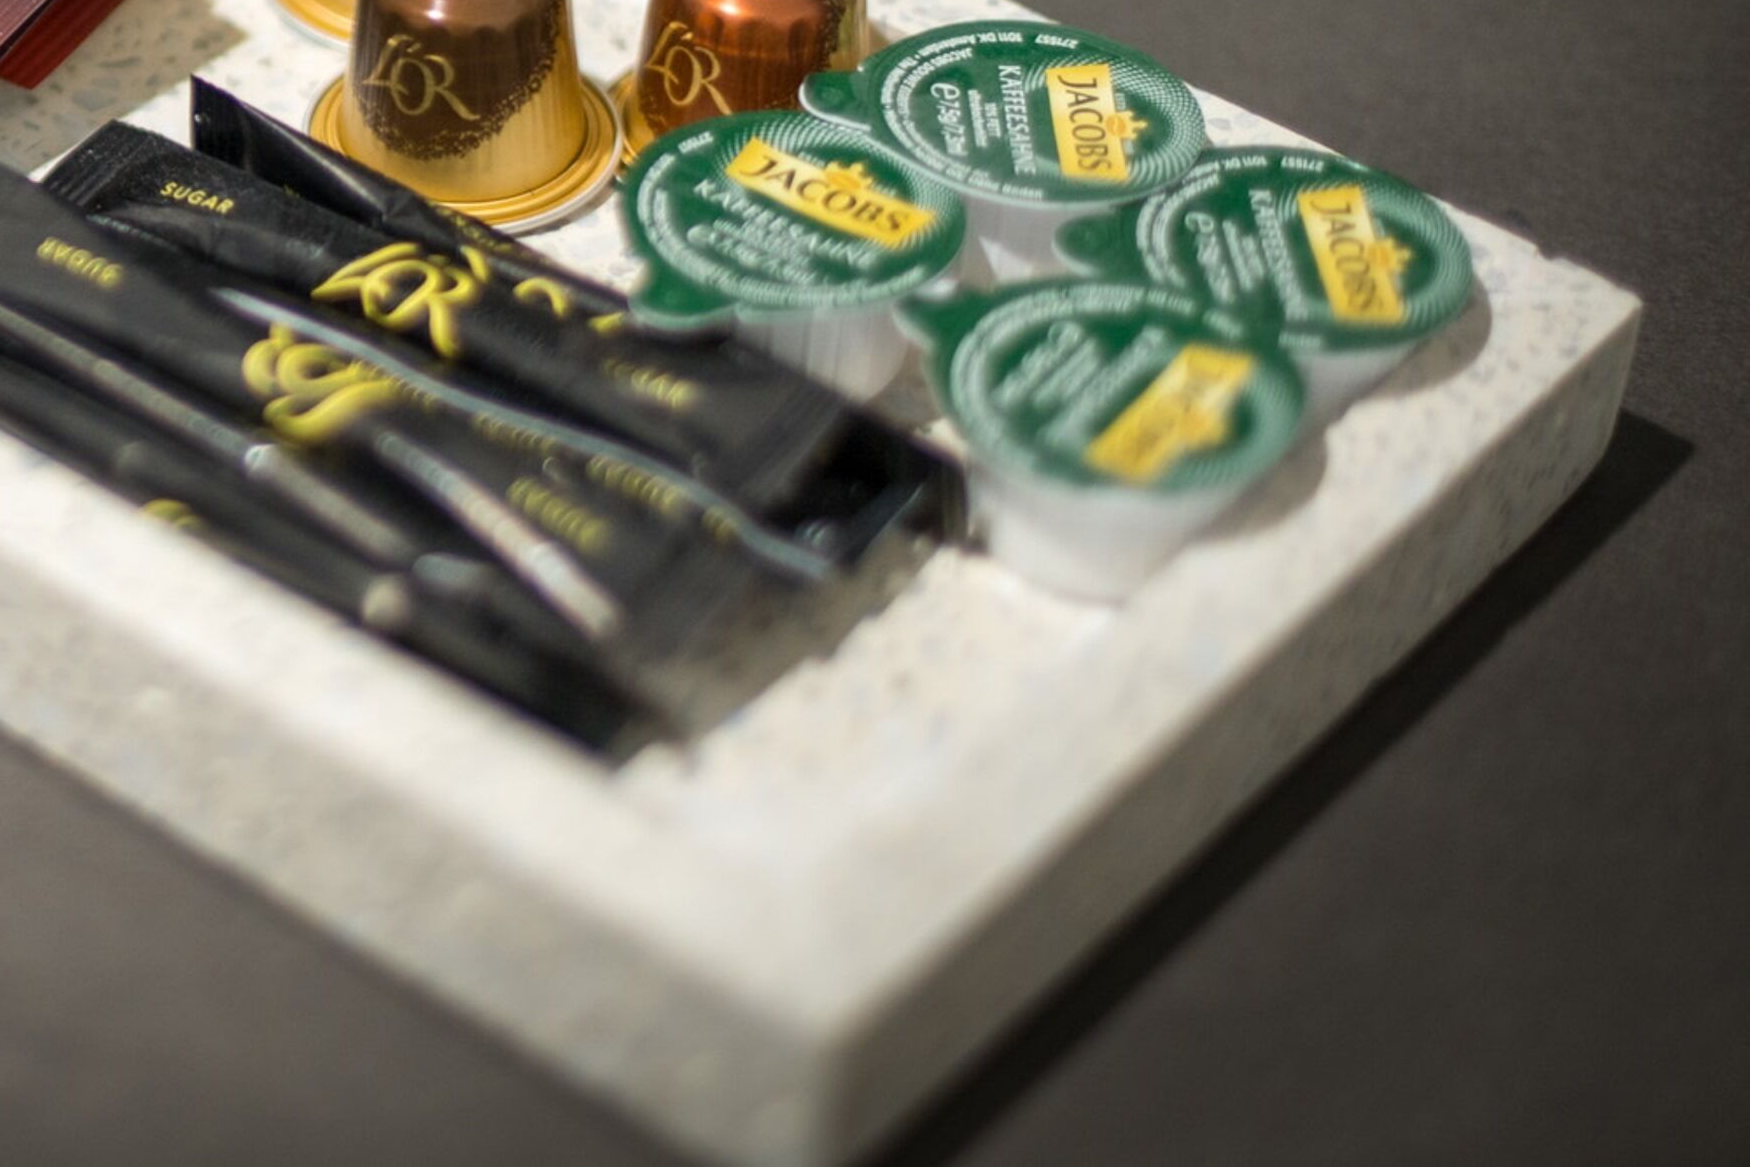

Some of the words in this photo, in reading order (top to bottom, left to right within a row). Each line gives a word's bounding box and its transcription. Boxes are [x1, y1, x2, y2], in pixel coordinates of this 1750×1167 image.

[997, 64, 1037, 176] KAFFEESAHNE
[1057, 74, 1113, 173] JACOBS
[160, 181, 235, 214] SUGAR
[738, 154, 911, 233] JACOBS
[37, 236, 124, 288] SUGAR
[1308, 197, 1384, 316] JACOBS
